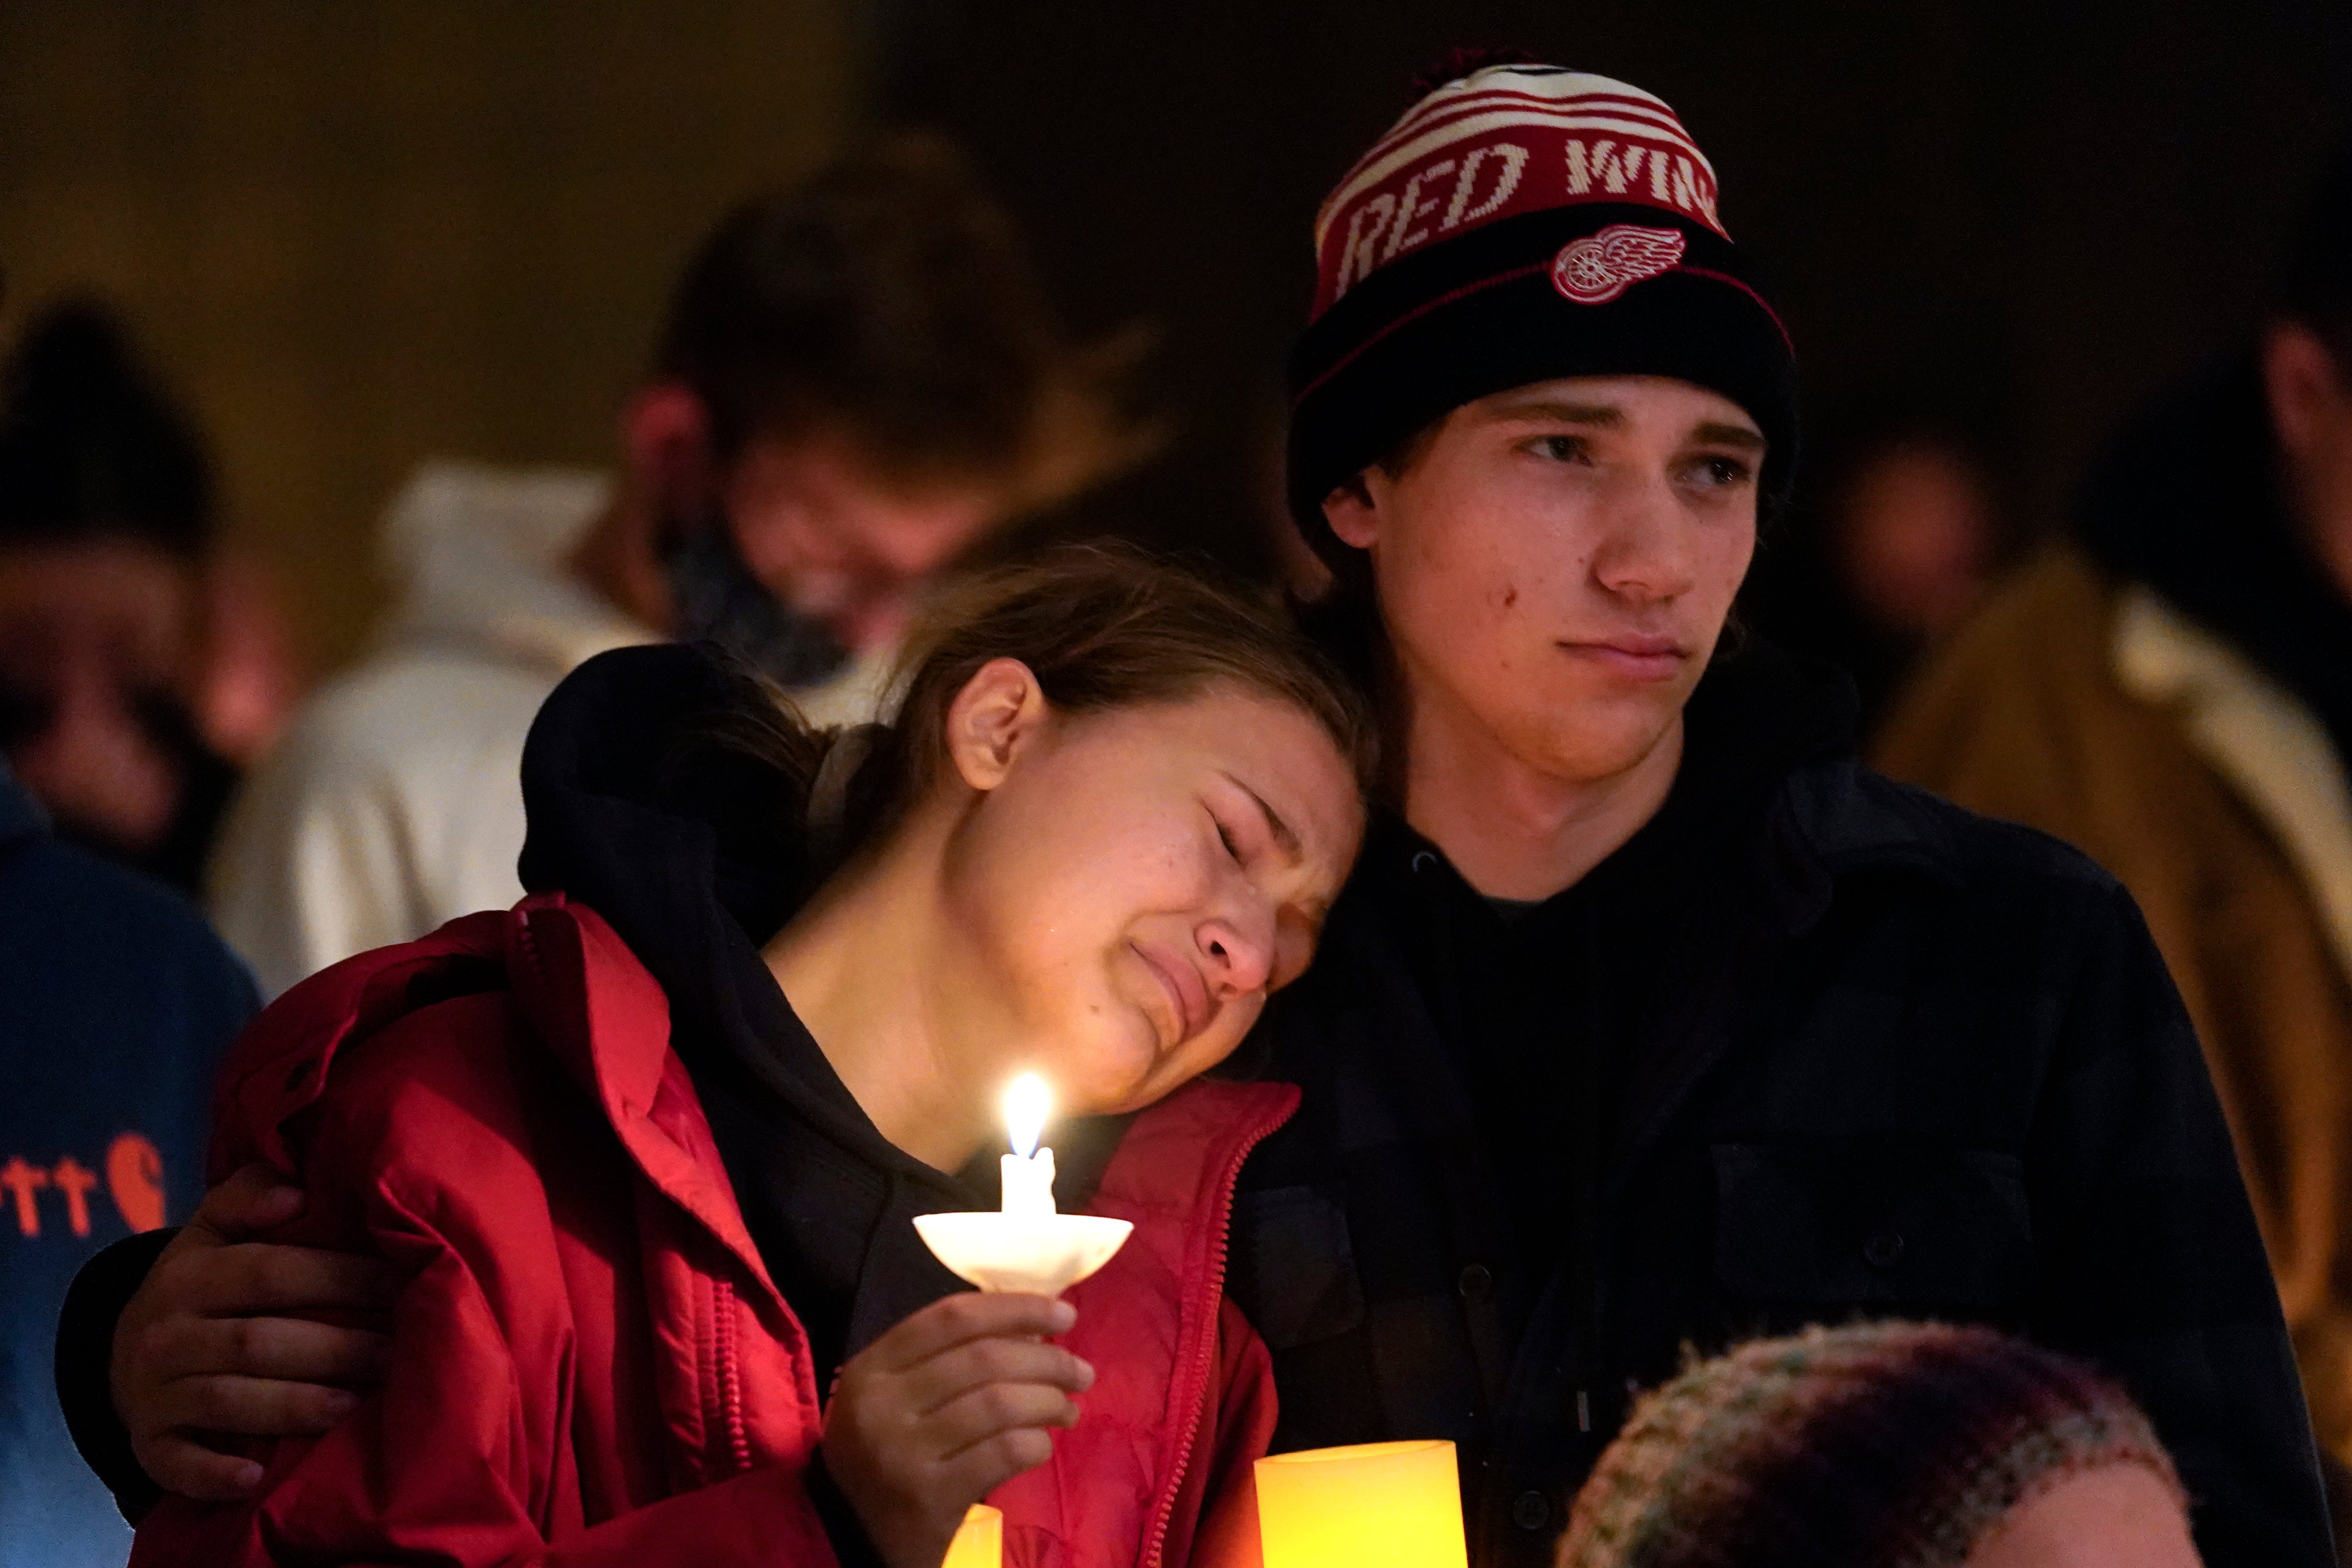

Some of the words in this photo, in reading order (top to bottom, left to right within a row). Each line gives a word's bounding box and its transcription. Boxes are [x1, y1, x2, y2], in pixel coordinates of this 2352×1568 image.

[1335, 143, 1530, 303] RED
[1565, 139, 1728, 238] WIN
[0, 1156, 97, 1237] tt
